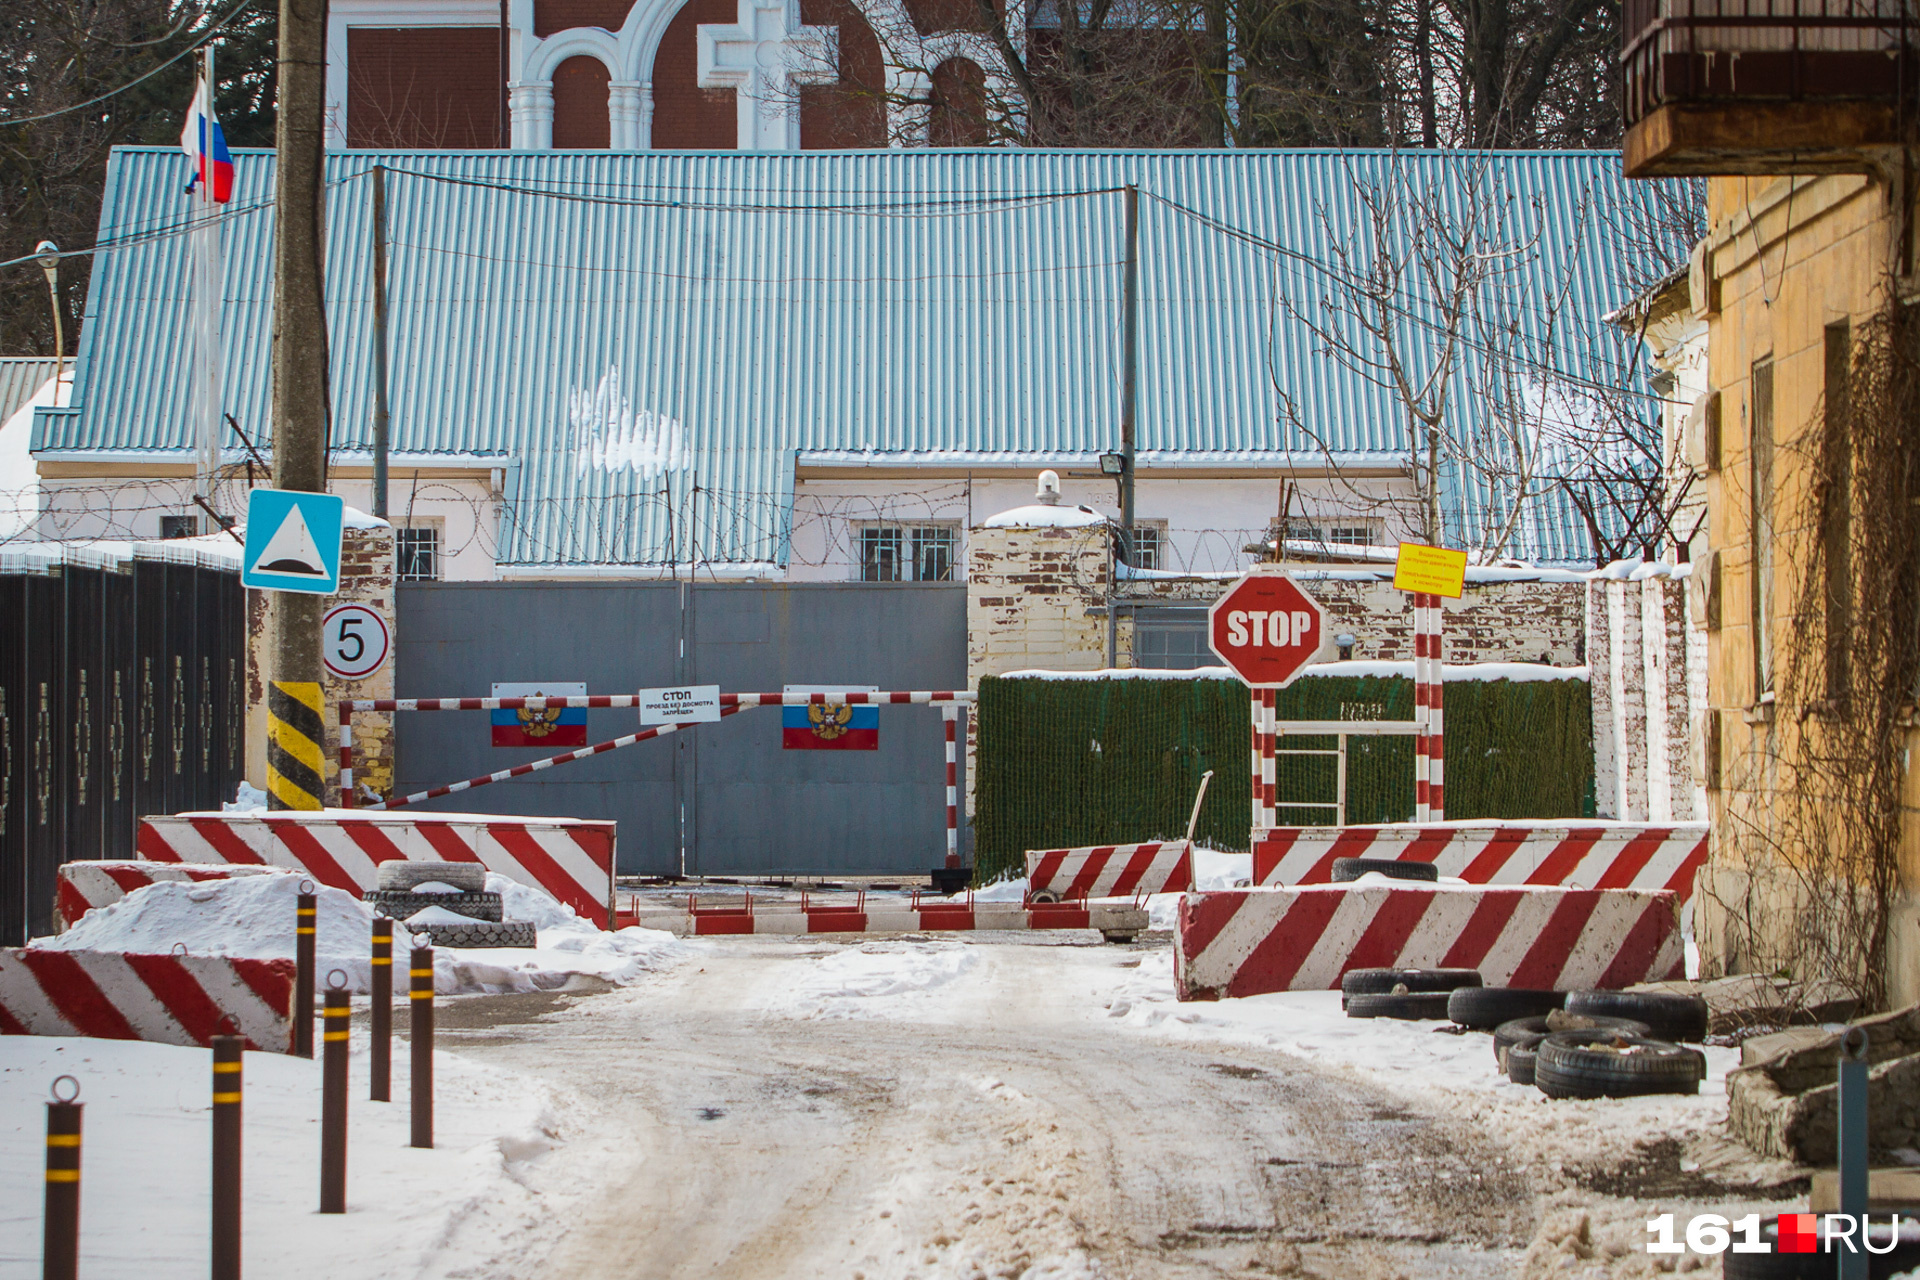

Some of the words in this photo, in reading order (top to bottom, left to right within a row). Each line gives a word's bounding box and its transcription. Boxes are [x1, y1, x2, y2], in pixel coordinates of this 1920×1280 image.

[338, 619, 364, 662] 5
[1227, 610, 1311, 647] STOP
[662, 691, 692, 700] СТОП
